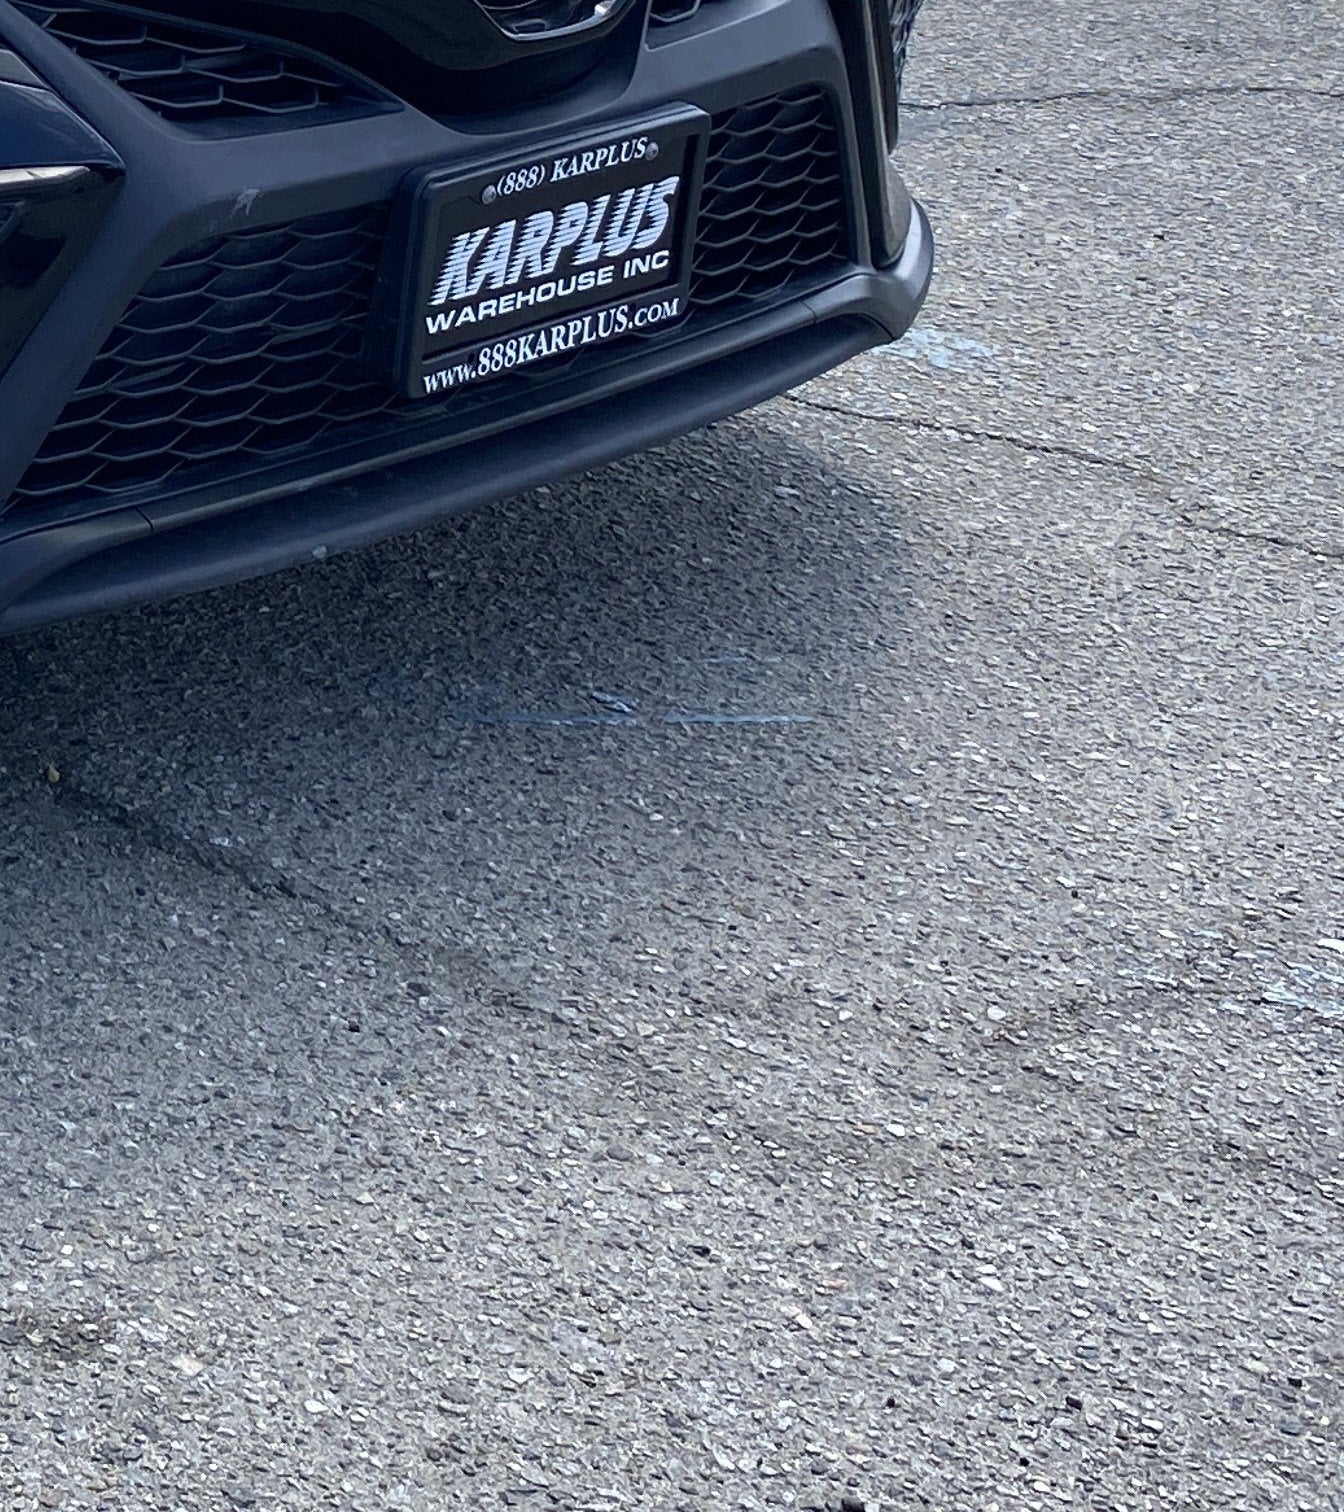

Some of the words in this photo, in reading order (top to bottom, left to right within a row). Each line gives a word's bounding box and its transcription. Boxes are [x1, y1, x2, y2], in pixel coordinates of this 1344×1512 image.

[497, 164, 546, 197] (888)
[550, 137, 648, 183] KARPLUS
[427, 175, 680, 306] KARPLUS
[425, 265, 615, 335] WAREHOUSE
[623, 250, 671, 279] INC
